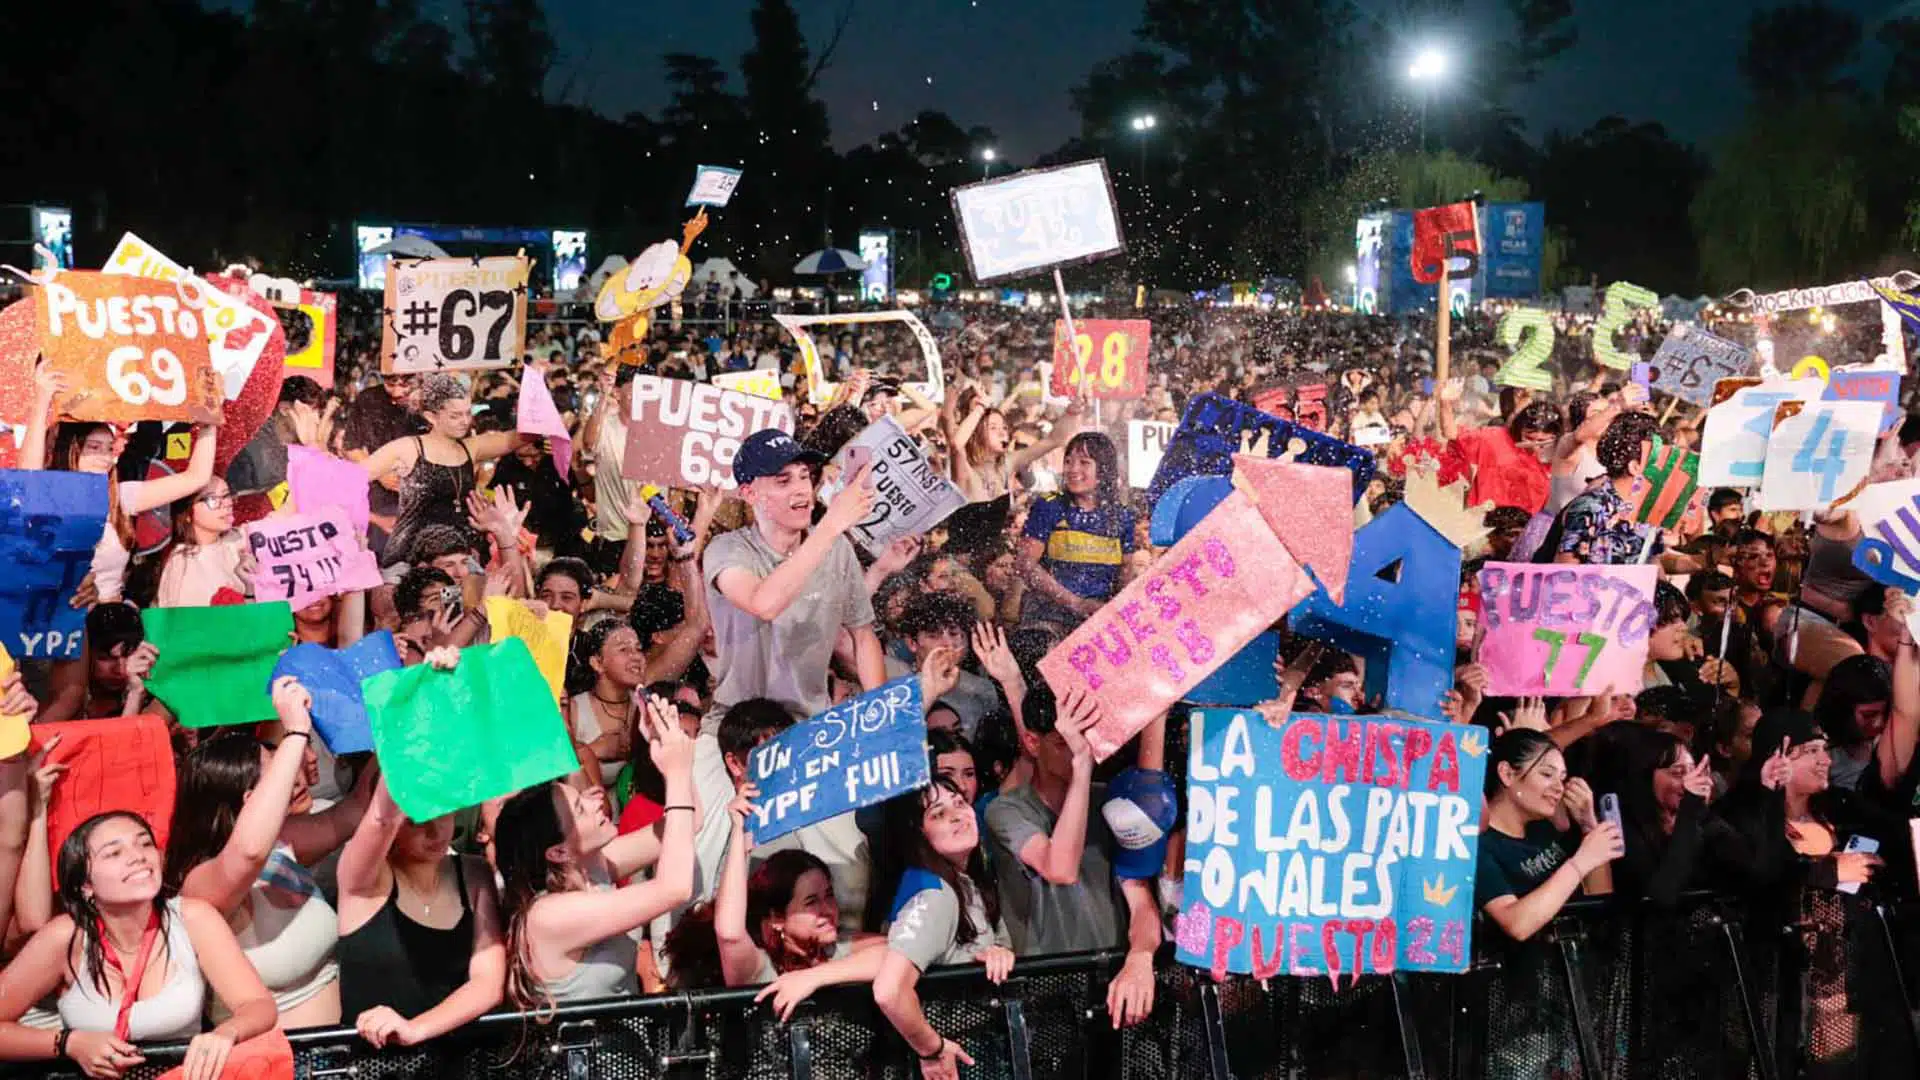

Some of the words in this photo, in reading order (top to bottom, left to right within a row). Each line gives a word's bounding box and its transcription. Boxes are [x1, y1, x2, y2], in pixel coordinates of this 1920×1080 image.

[46, 283, 199, 340] PUESTO
[403, 289, 515, 361] #67
[106, 346, 187, 406] 69
[631, 374, 796, 438] PUESTO
[888, 438, 920, 465] 57
[872, 459, 917, 516] PUESTO
[249, 521, 338, 562] PUESTO
[1068, 537, 1237, 691] PUESTO
[1479, 567, 1659, 649] PUESTO
[20, 631, 83, 656] YPF
[1532, 626, 1607, 689] 77
[806, 750, 840, 780] EN
[1190, 711, 1256, 781] LA
[1280, 719, 1460, 792] CHISPA
[751, 782, 817, 828] YPF
[1187, 786, 1240, 846] DE
[1255, 785, 1350, 853] LAS
[1211, 916, 1397, 985] PUESTO
[1407, 917, 1464, 965] 24
